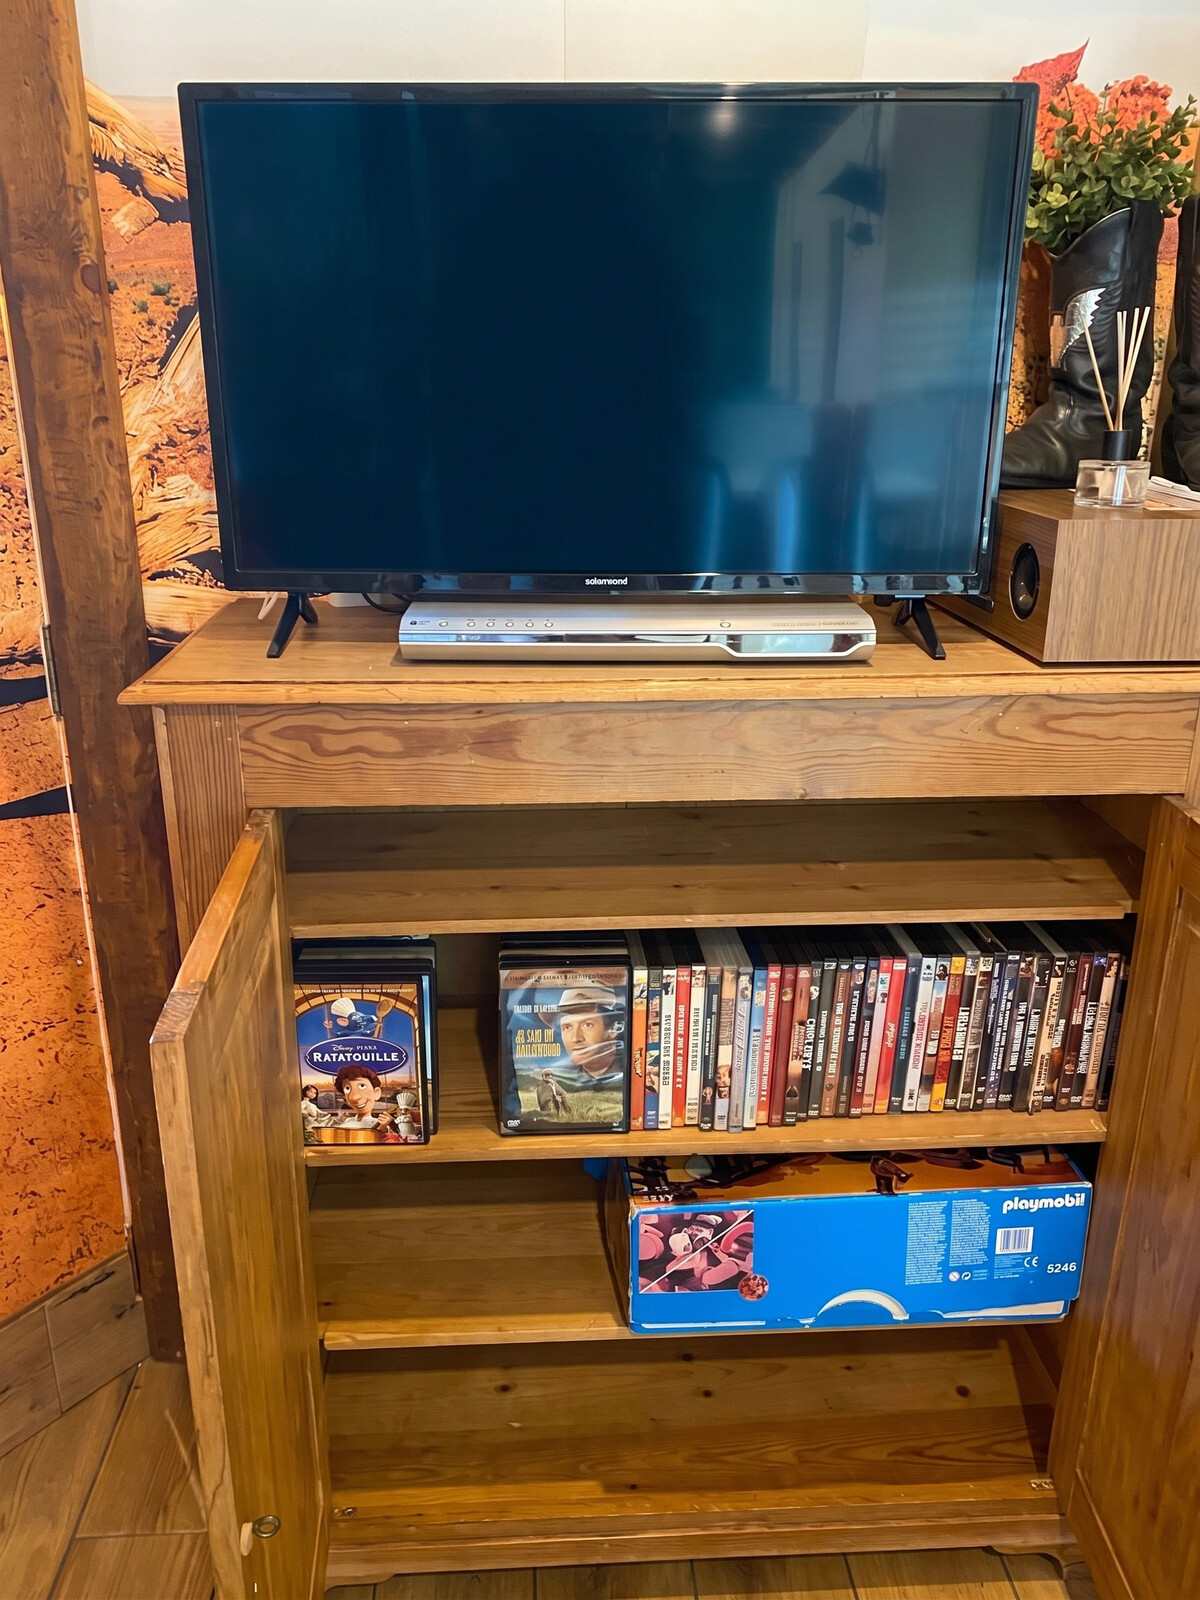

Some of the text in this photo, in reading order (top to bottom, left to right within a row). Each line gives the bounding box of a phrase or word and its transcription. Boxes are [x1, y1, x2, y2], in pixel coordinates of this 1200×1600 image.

[313, 1052, 399, 1062] RATATOUILLE
[1002, 1192, 1086, 1215] playmobil
[1046, 1261, 1077, 1274] 5246
